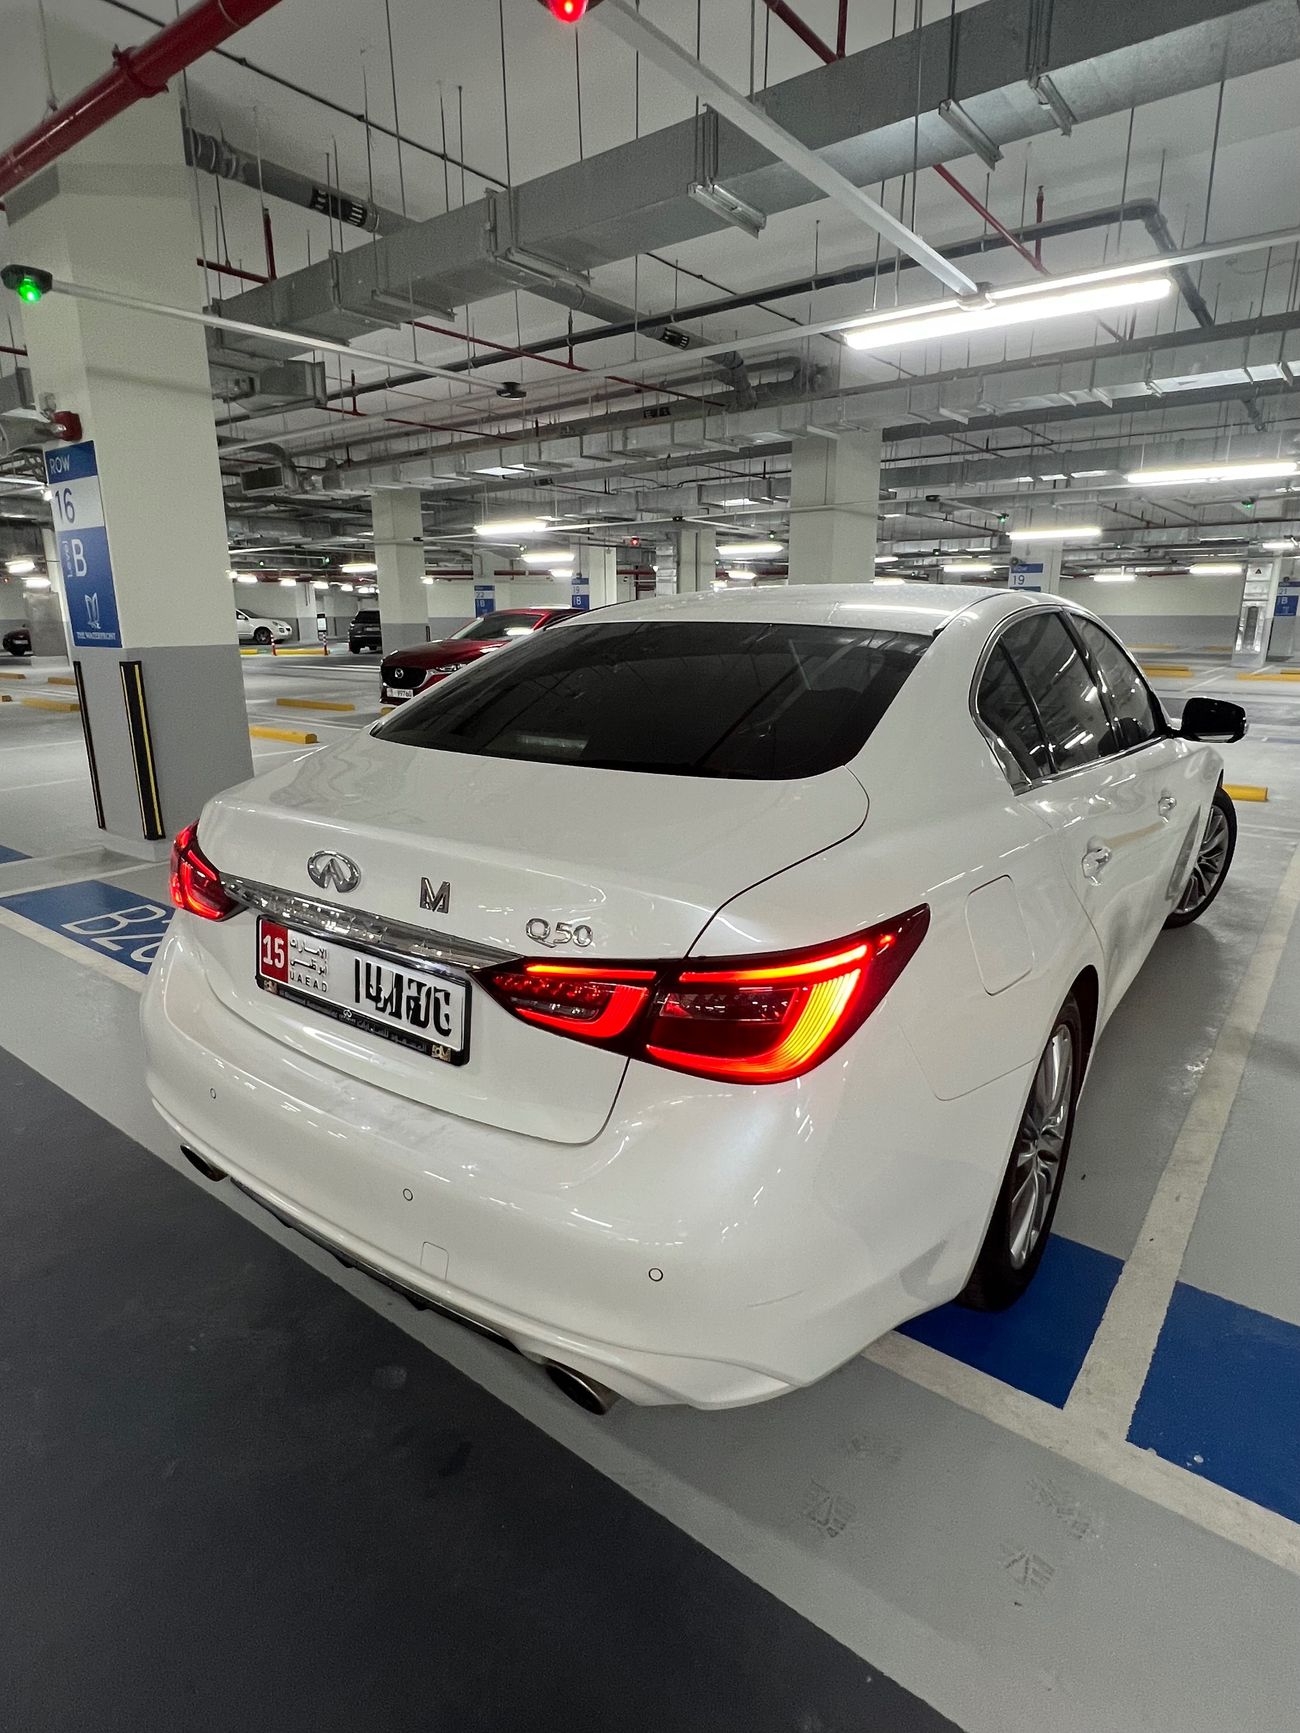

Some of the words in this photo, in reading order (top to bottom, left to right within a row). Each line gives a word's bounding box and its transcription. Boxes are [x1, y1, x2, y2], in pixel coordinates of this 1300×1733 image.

[49, 454, 70, 474] ROW
[55, 487, 75, 524] 16
[71, 538, 87, 576] B
[1013, 575, 1025, 585] 19
[419, 877, 450, 914] M
[525, 917, 594, 948] Q50
[263, 935, 285, 968] 15
